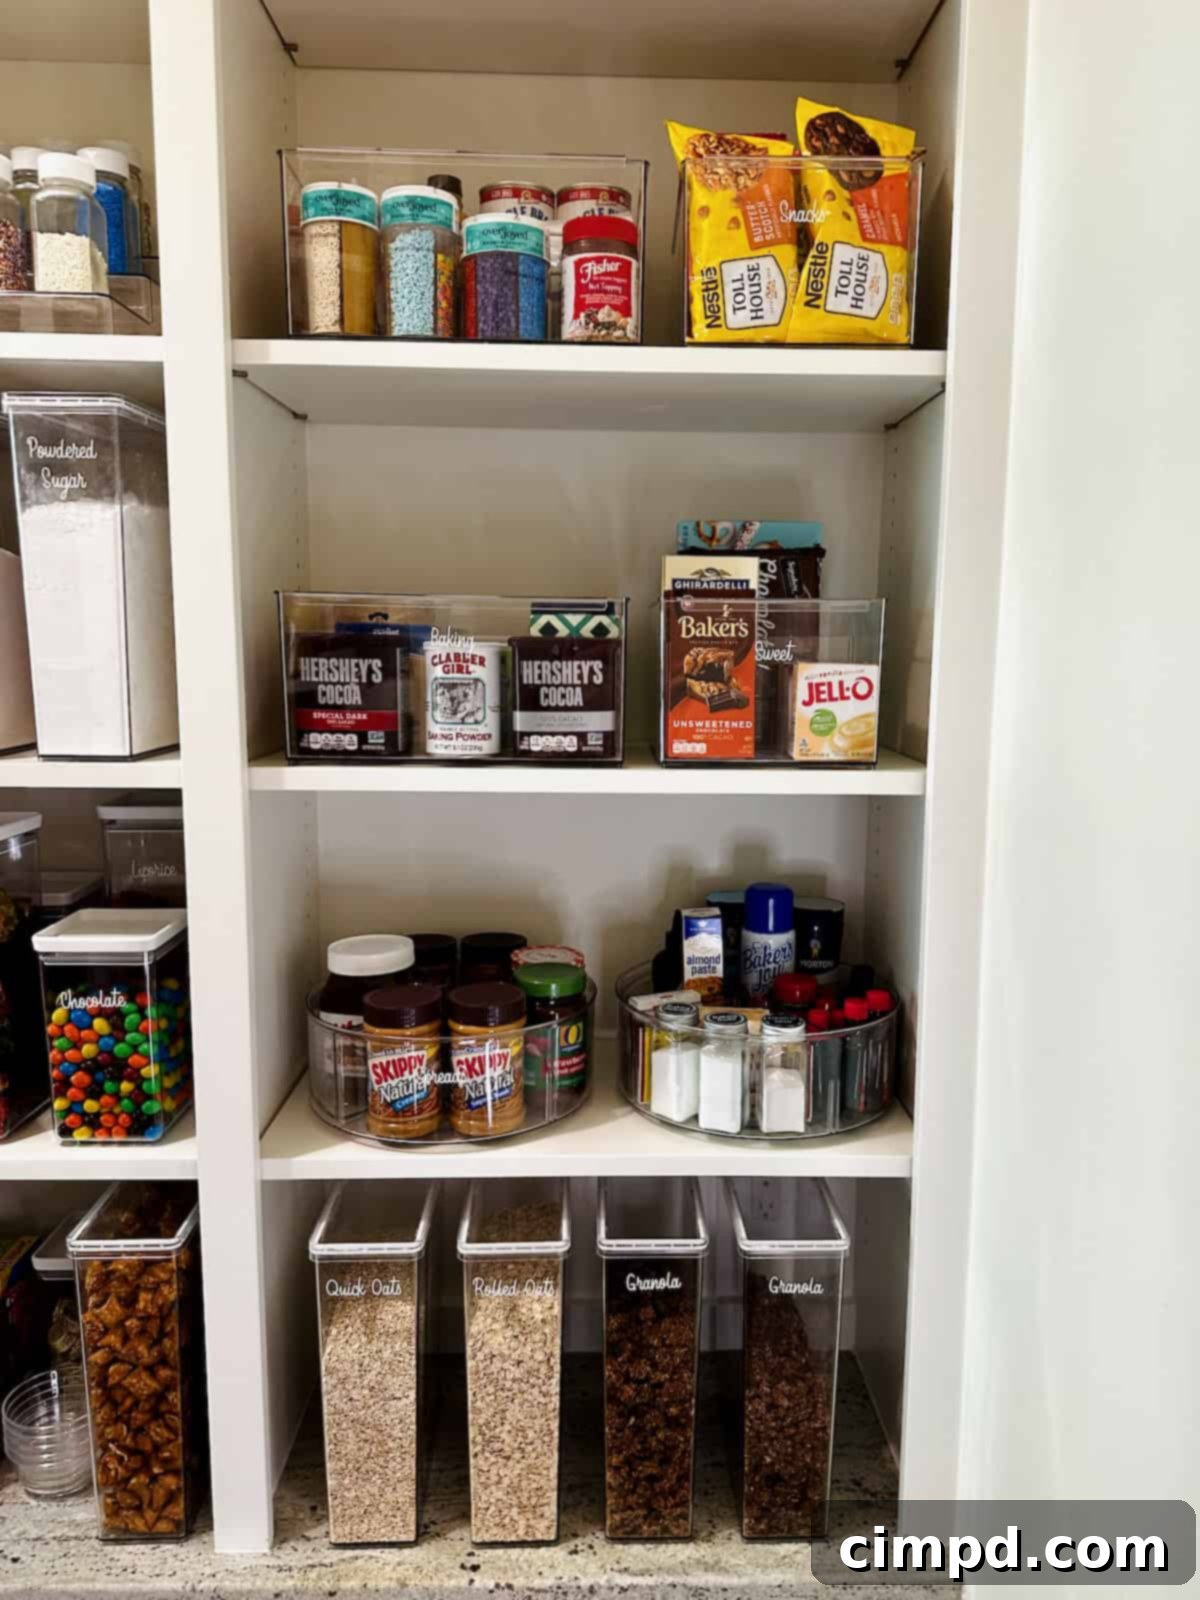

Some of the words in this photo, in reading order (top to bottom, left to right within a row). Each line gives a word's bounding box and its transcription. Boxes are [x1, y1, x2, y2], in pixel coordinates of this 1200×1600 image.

[746, 204, 764, 242] BUTTER
[758, 201, 775, 240] SCOTCH
[779, 199, 827, 223] Snacks
[580, 258, 622, 284] Fisher
[834, 258, 854, 298] TOLL
[850, 252, 870, 310] HOUSE
[731, 273, 747, 315] TOLL
[747, 262, 764, 321] HOUSE
[26, 435, 98, 460] Powdered
[41, 466, 87, 500] Sugar
[674, 580, 747, 590] GHIRARDELLI
[430, 625, 475, 652] Baking
[677, 615, 749, 639] Baker's
[755, 640, 797, 661] Sweet
[300, 657, 383, 684] HERSHEY'S
[442, 664, 472, 675] GIRL
[522, 660, 604, 685] HERSHEY'S
[318, 684, 362, 705] COCOA
[540, 686, 584, 707] COCOA
[312, 711, 344, 719] SPECIAL
[673, 720, 753, 729] UNSWEETENED
[455, 732, 492, 741] POWDER
[687, 954, 721, 965] almond
[691, 964, 717, 975] paste
[56, 986, 128, 1010] Chocolate
[371, 1054, 425, 1086] SKIPPY
[325, 1278, 366, 1297] Quick
[371, 1276, 402, 1297] Oats
[472, 1277, 518, 1297] Rolled
[523, 1277, 557, 1297] Oats
[626, 1272, 682, 1292] Granola
[768, 1276, 824, 1295] Granola
